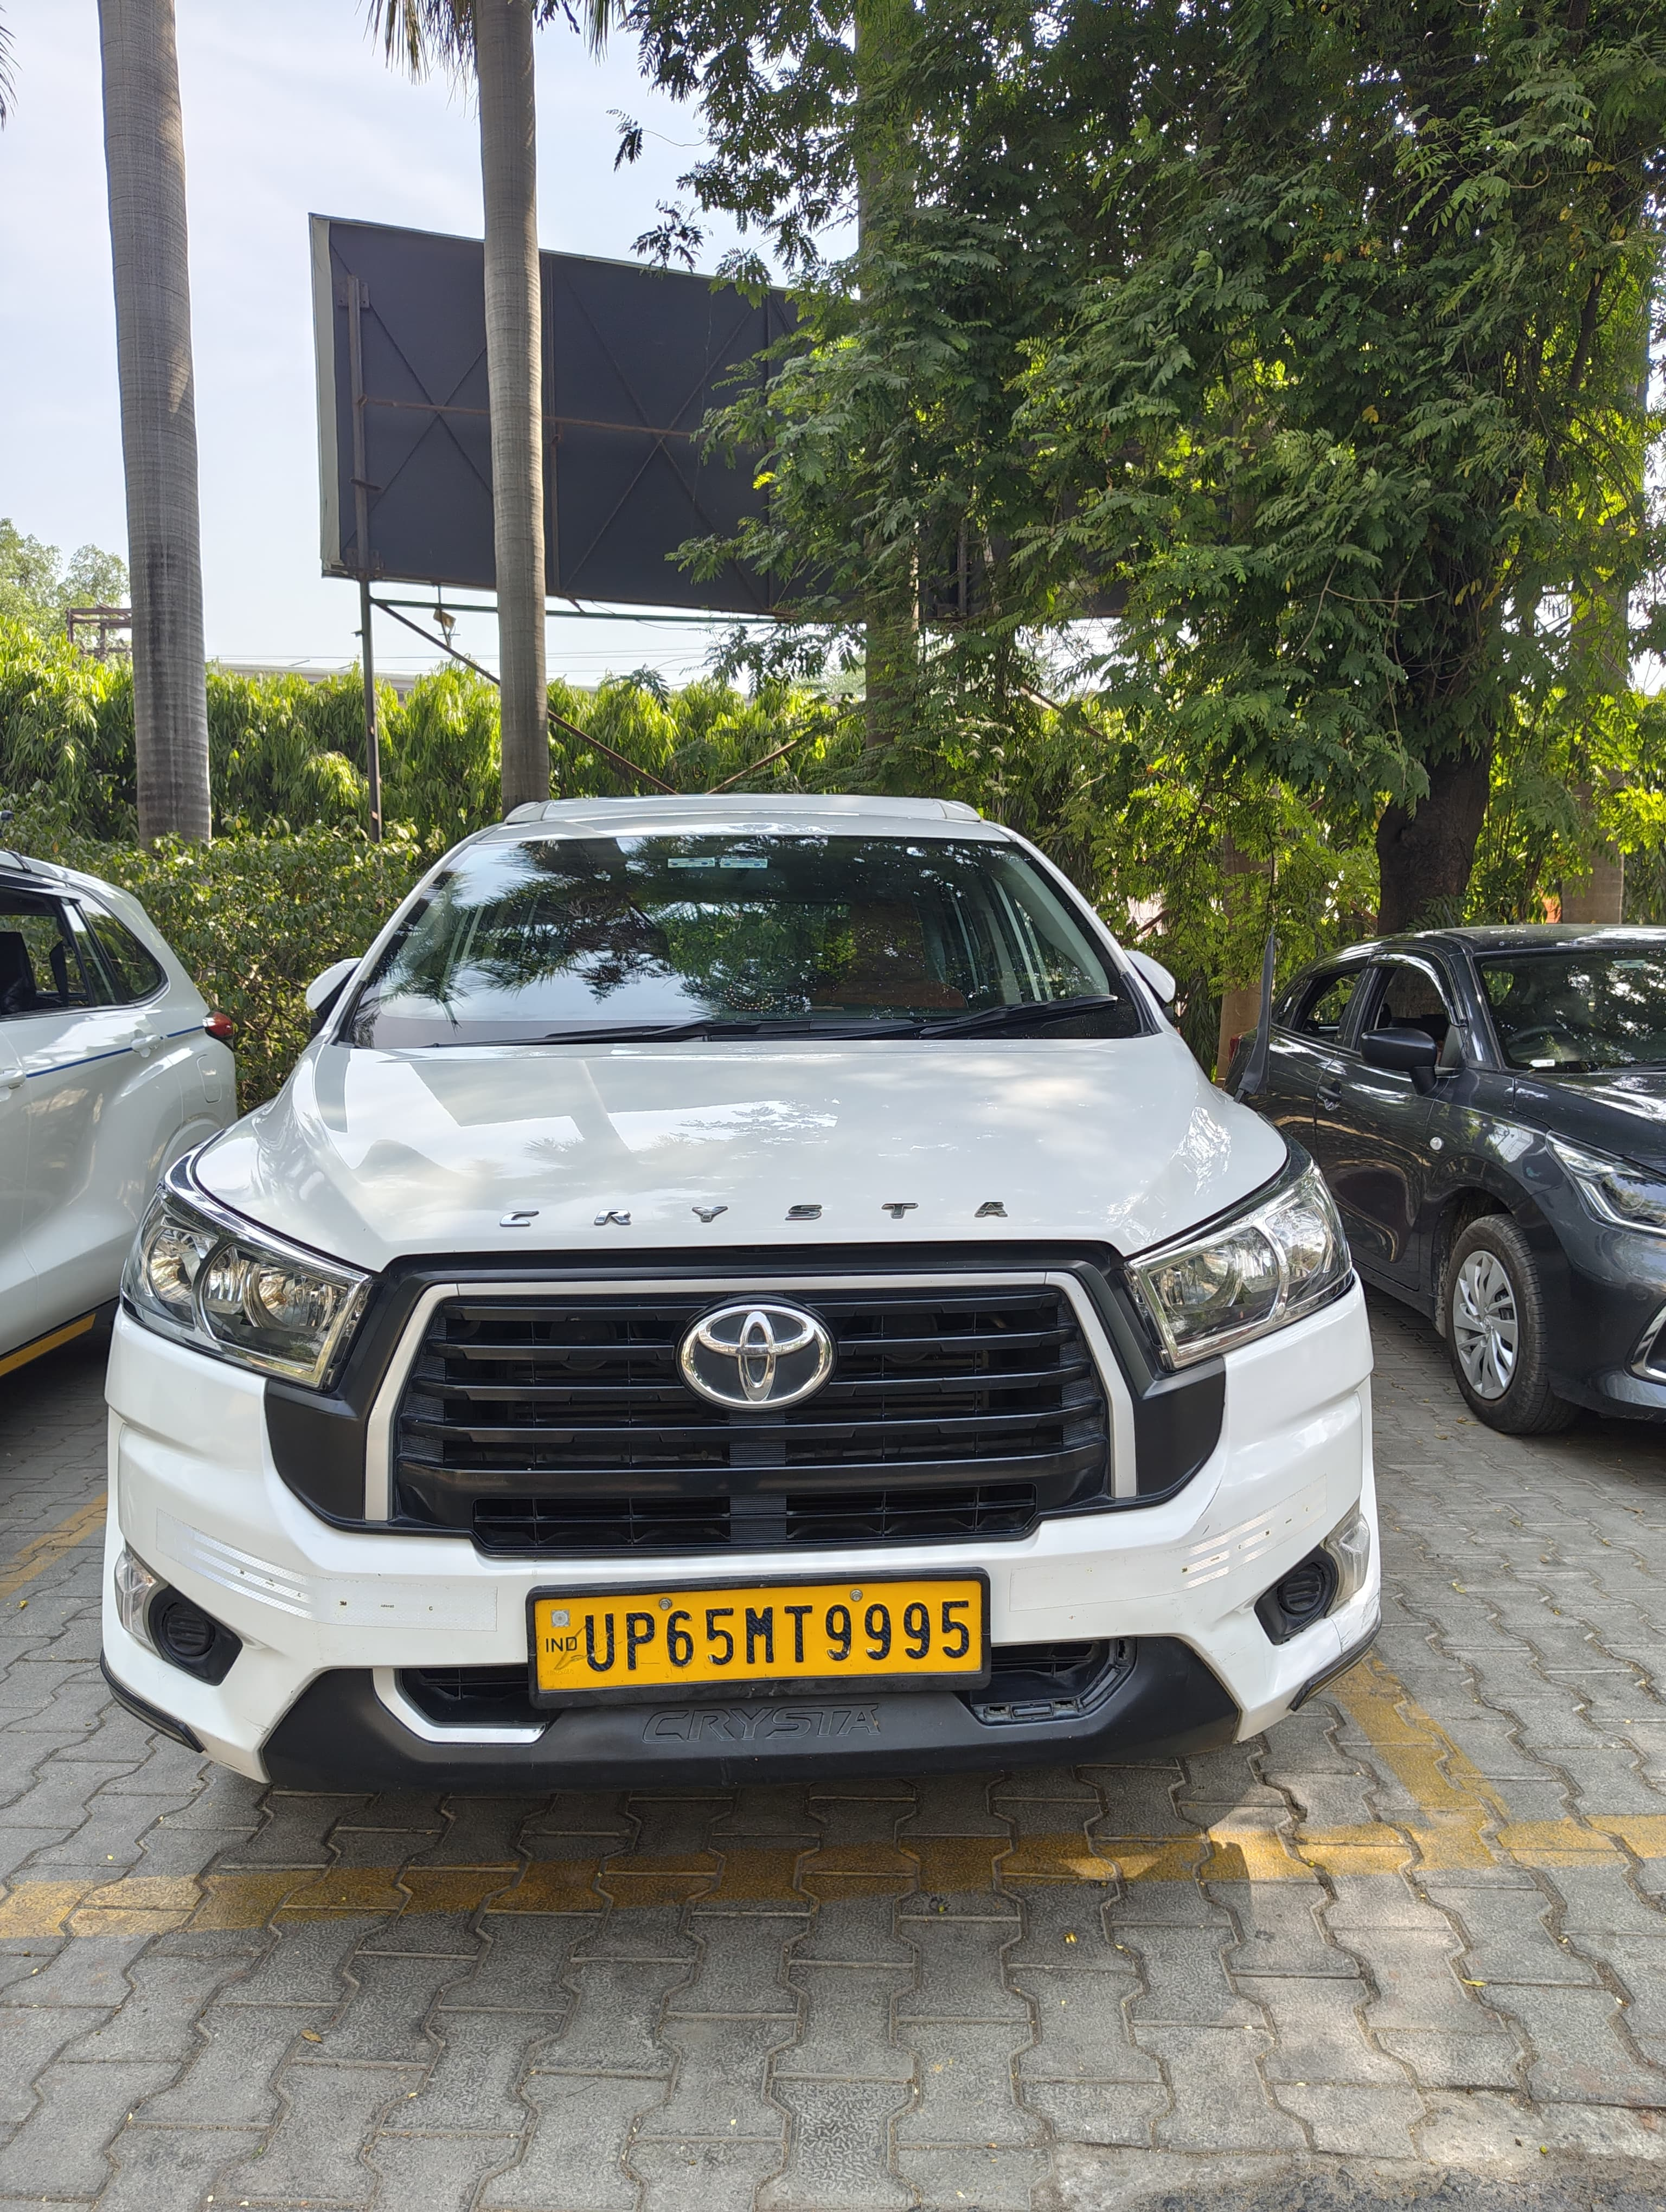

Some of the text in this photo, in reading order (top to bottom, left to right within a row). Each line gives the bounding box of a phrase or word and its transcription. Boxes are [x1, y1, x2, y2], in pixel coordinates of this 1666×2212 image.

[499, 1201, 1009, 1227] CRYSTA
[546, 1636, 578, 1653] IND
[585, 1600, 970, 1672] UP65MT9995
[642, 1702, 881, 1743] CRYSTA
